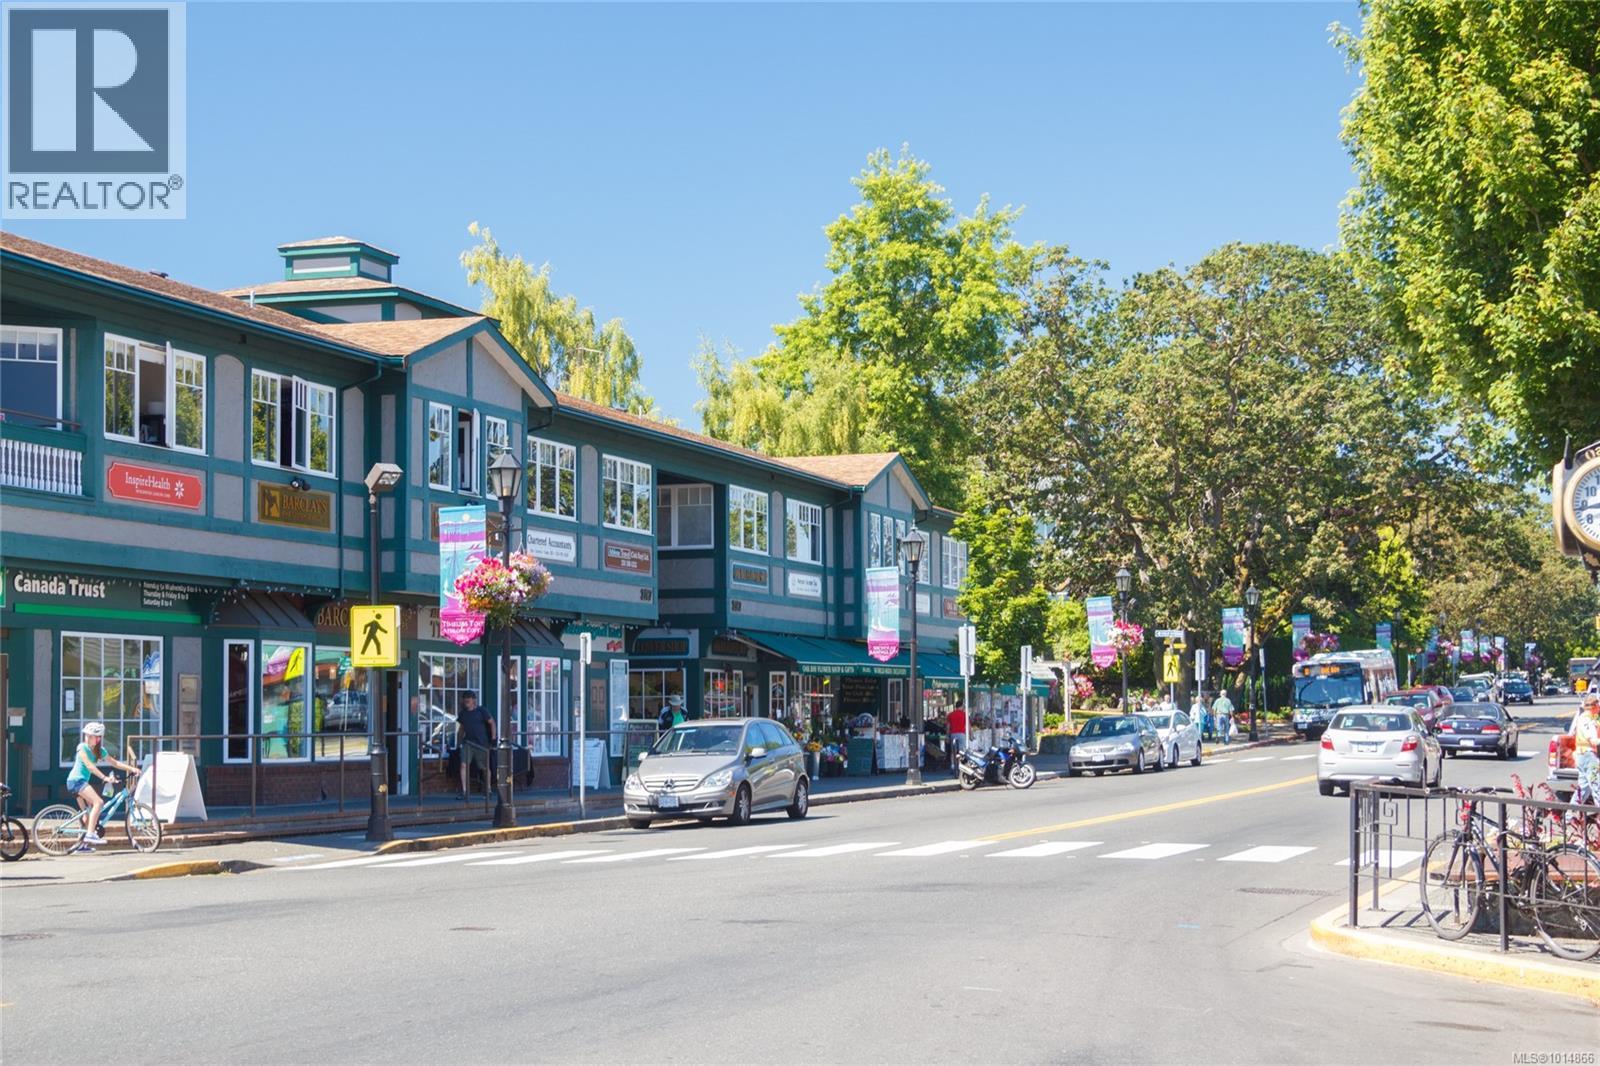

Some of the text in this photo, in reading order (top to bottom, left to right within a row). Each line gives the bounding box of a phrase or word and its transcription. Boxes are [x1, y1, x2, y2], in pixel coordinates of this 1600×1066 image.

[124, 471, 171, 491] InspireHealth
[1585, 486, 1597, 497] 10
[1586, 513, 1593, 524] 8
[14, 574, 66, 596] Canada
[69, 578, 106, 599] Trust
[317, 607, 349, 628] BARC
